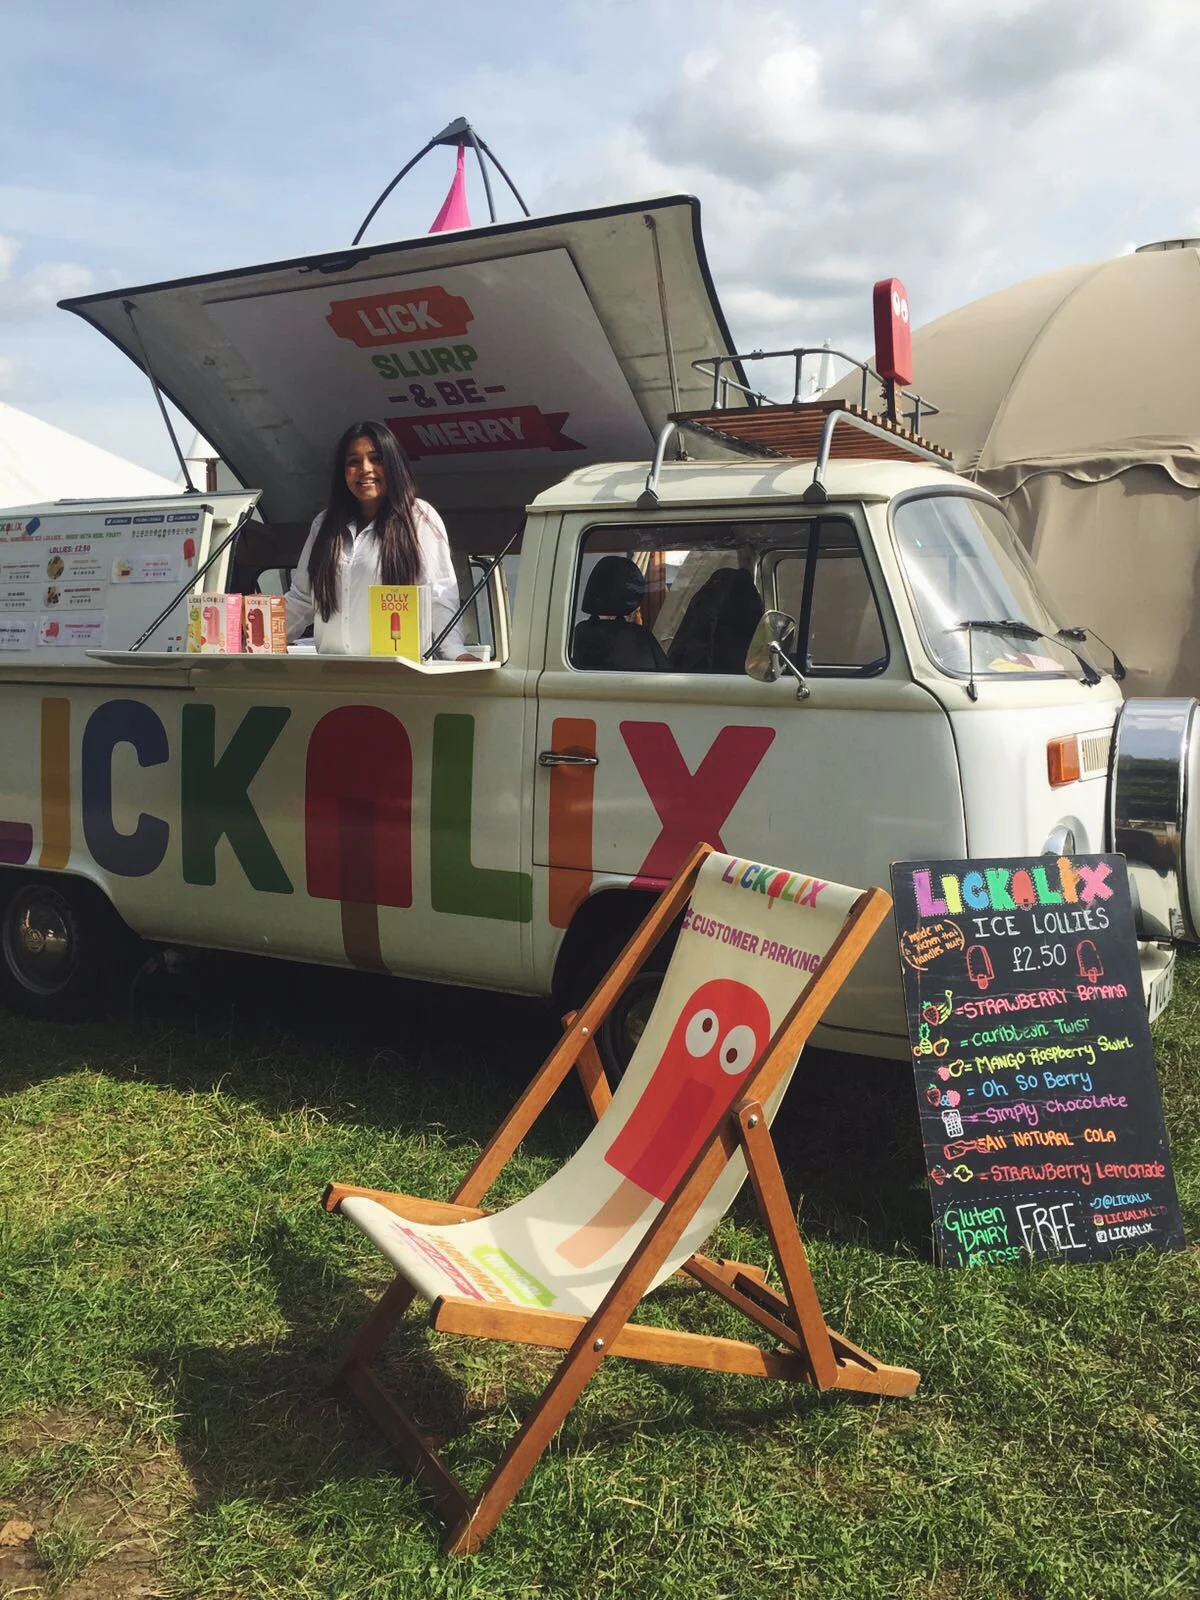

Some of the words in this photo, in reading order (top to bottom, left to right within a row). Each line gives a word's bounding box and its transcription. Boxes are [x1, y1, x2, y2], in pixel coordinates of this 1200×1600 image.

[357, 300, 443, 337] LICK
[371, 344, 479, 380] SLURP
[433, 378, 487, 406] BE
[412, 416, 526, 447] MERRY
[380, 593, 409, 603] LOLLY
[381, 602, 409, 612] BOOK
[0, 697, 777, 975] ICKALIX
[912, 856, 1115, 918] LICKALIX
[972, 916, 1021, 938] ICE
[691, 913, 761, 955] CUSTOMER
[759, 938, 823, 975] PARKING
[1012, 943, 1068, 973] £2.50
[975, 1052, 1026, 1075] MANGO
[982, 1079, 1008, 1098] Oh
[1043, 1071, 1093, 1093] Berry
[1014, 1130, 1075, 1147] NATURAL
[1083, 1127, 1117, 1144] COLA
[944, 1206, 1006, 1243] Gluten
[1014, 1202, 1087, 1253] FREE
[961, 1224, 1009, 1252] DAIRY
[1108, 1222, 1153, 1241] LICKALIX
